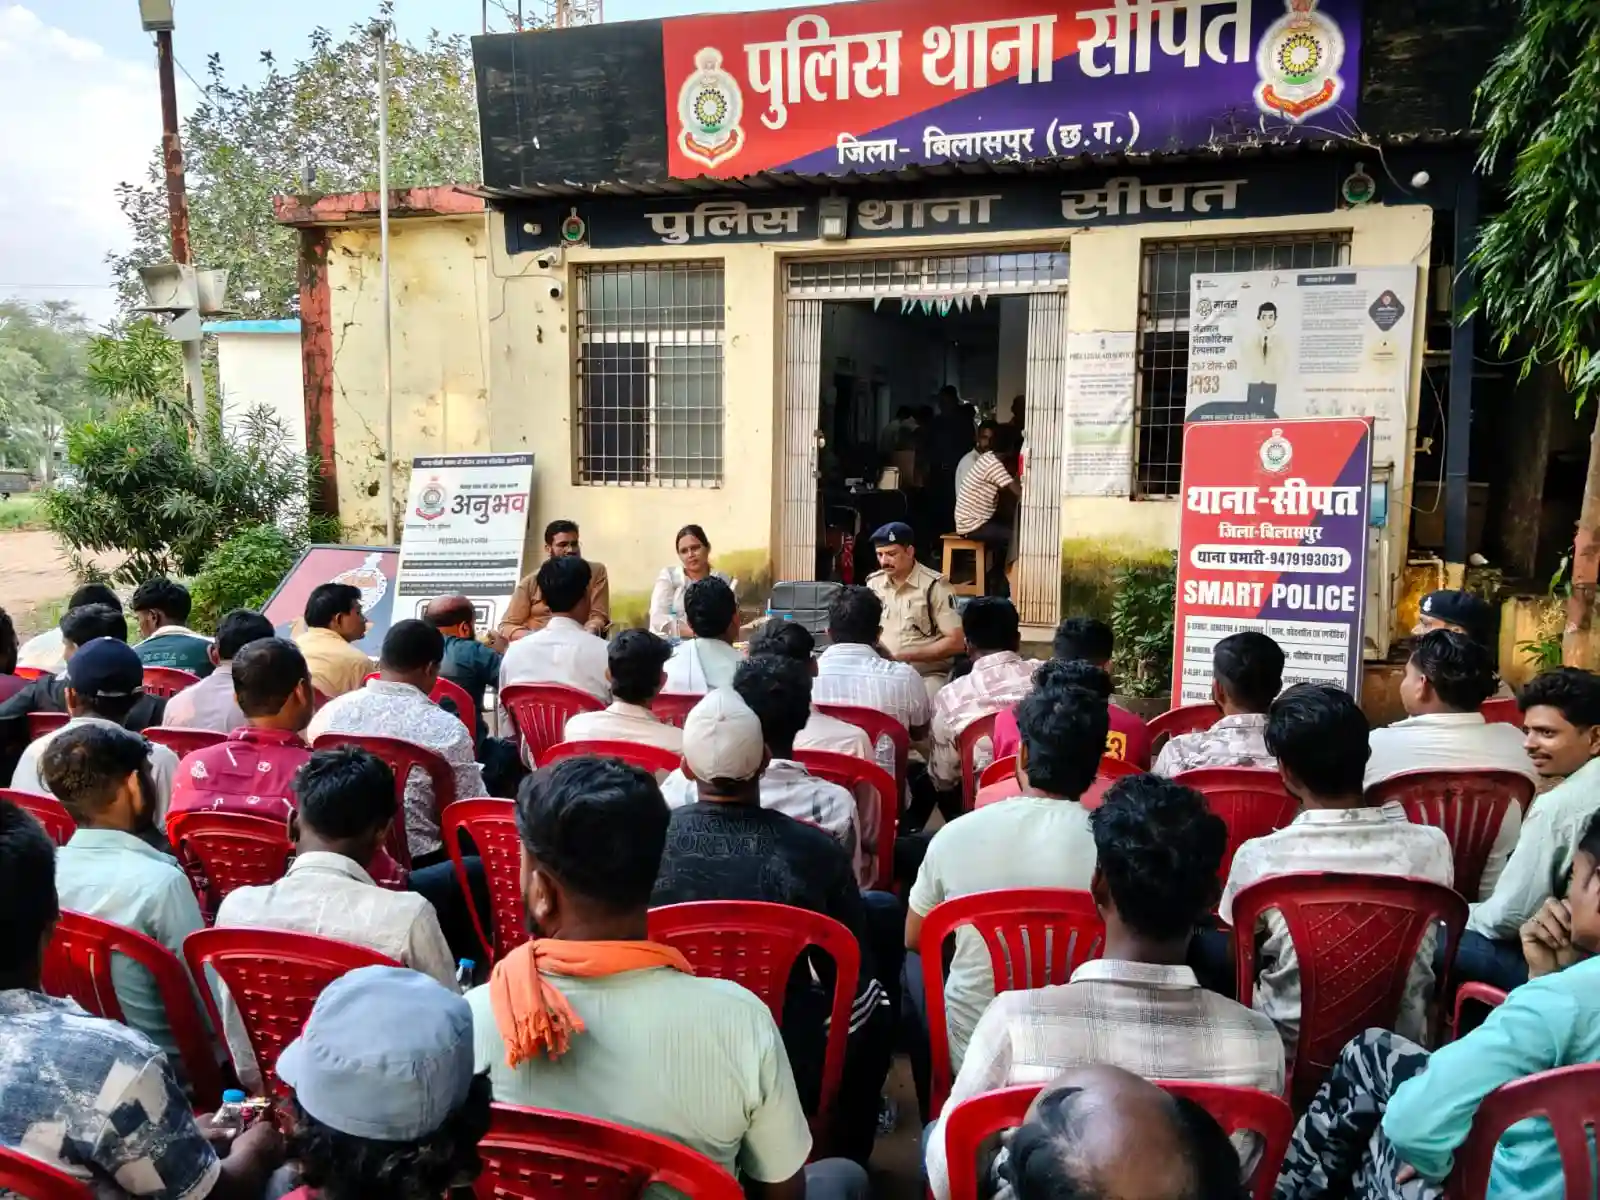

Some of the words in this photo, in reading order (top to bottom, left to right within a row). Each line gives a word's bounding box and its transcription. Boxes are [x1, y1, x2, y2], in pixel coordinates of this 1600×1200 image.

[744, 14, 903, 130] पुलिस
[922, 14, 1057, 91] थाना
[1077, 0, 1254, 79] सीपत
[923, 125, 1036, 162] बिलासपुर
[643, 201, 805, 244] पुलिस
[857, 194, 1002, 232] थाना
[1061, 176, 1248, 220] सीपत
[1189, 375, 1221, 395] 1933
[451, 492, 529, 524] अनुभव
[1197, 551, 1226, 564] थाना
[1183, 580, 1264, 607] SMART
[1271, 583, 1356, 612] POLICE
